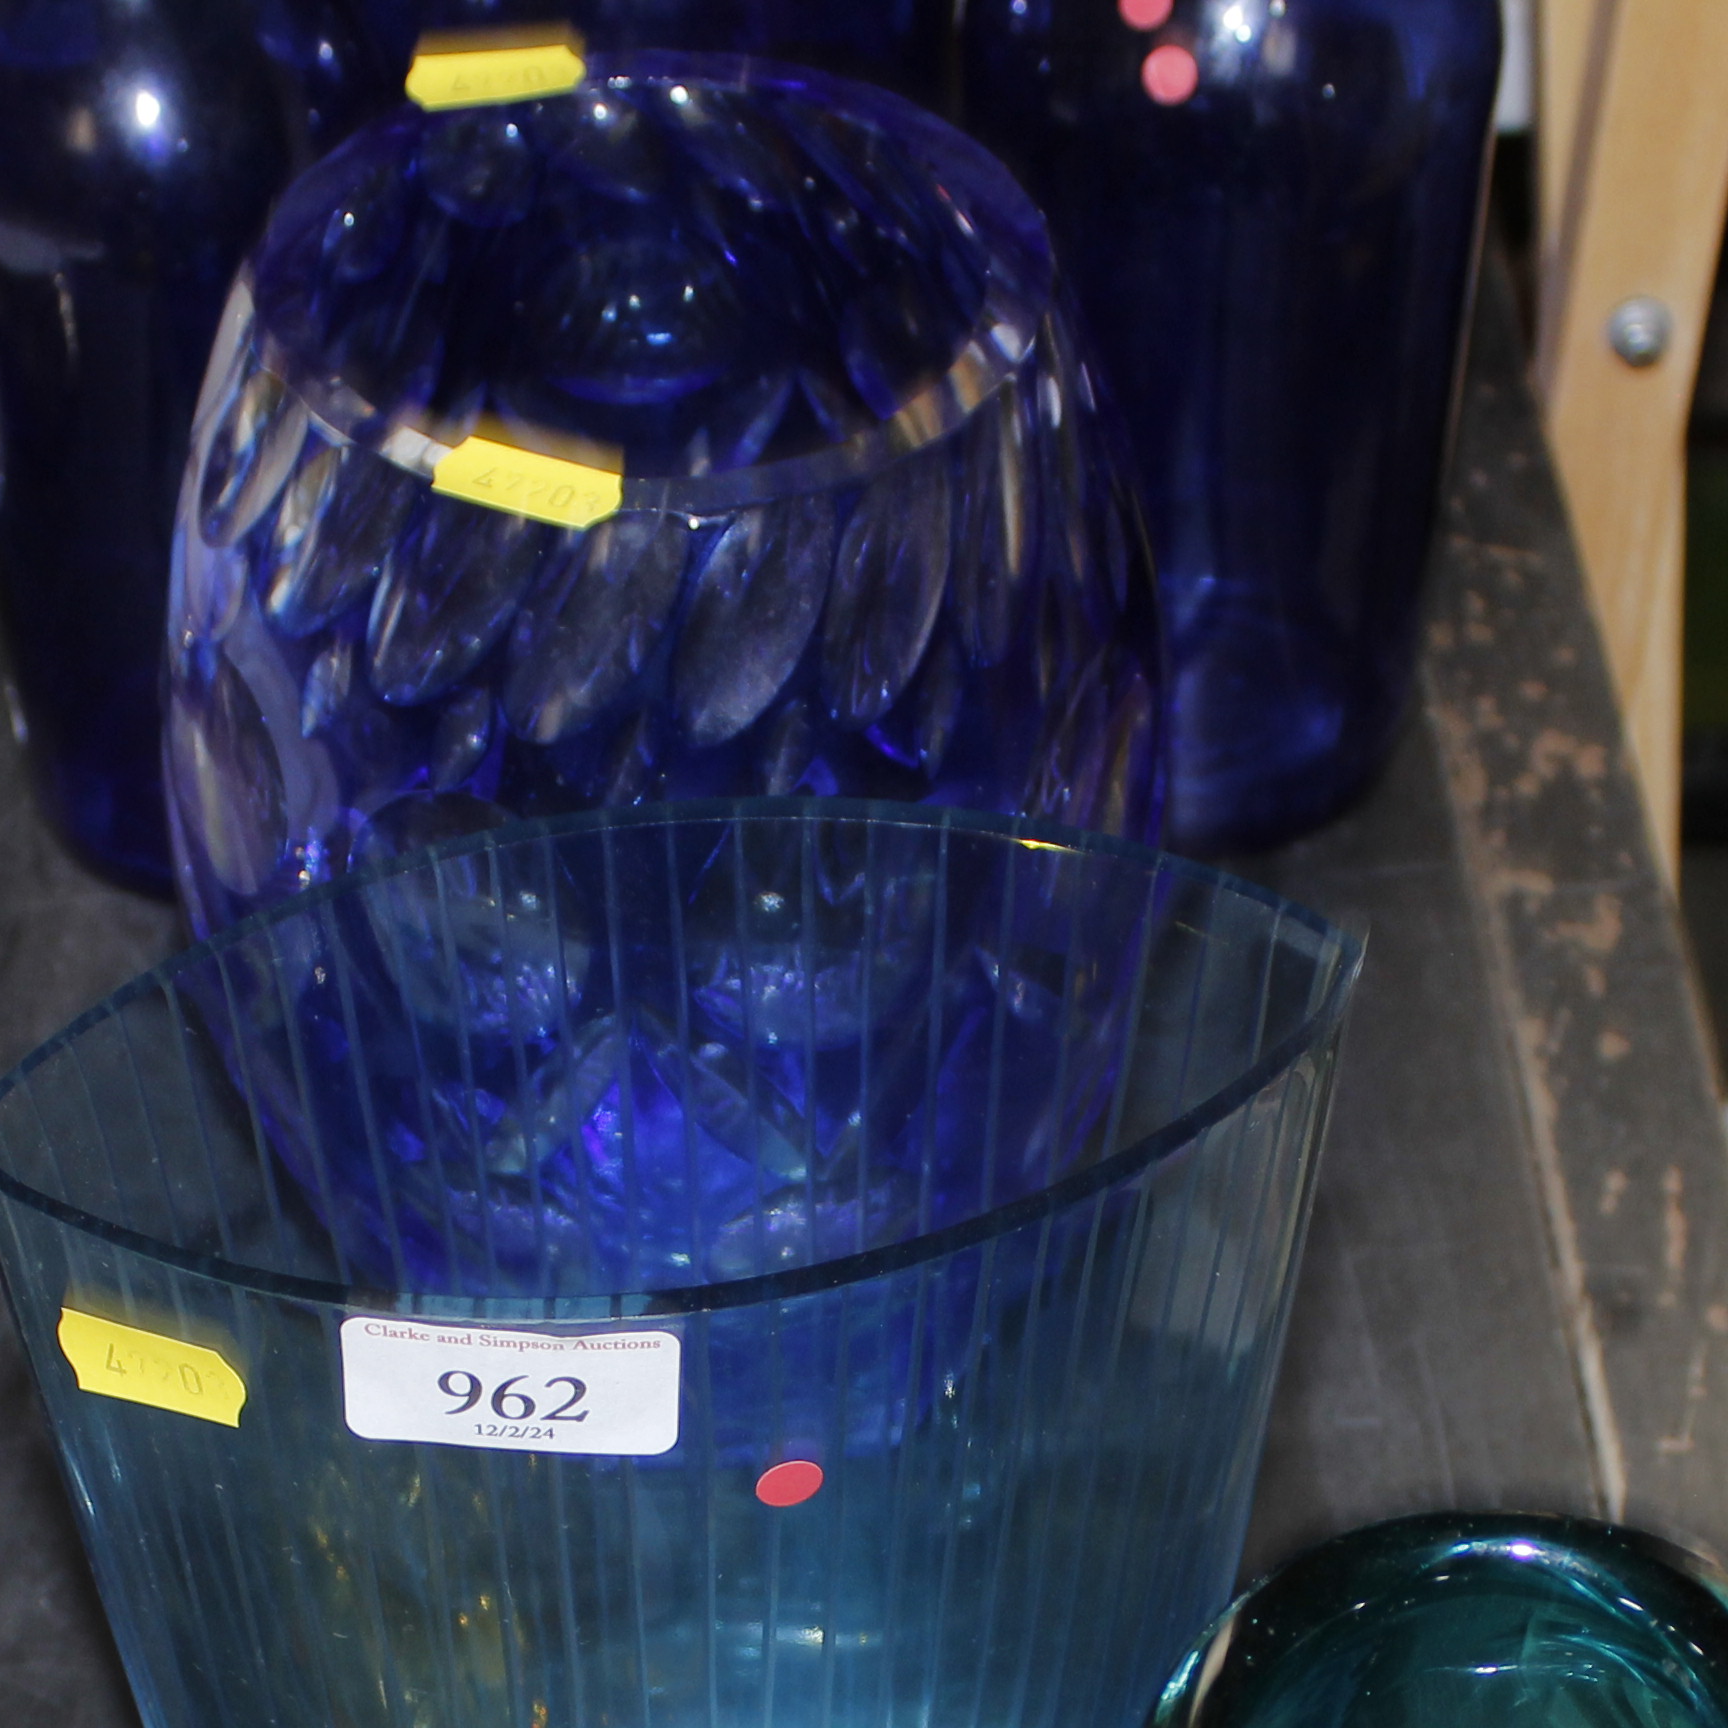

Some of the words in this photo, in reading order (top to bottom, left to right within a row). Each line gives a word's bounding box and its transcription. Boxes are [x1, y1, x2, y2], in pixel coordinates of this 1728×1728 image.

[364, 1322, 430, 1342] Clarke
[437, 1332, 472, 1346] and
[479, 1334, 565, 1352] Simpson
[573, 1338, 662, 1351] Auctions
[438, 1370, 591, 1423] 962
[474, 1423, 556, 1441] 12/2/24
